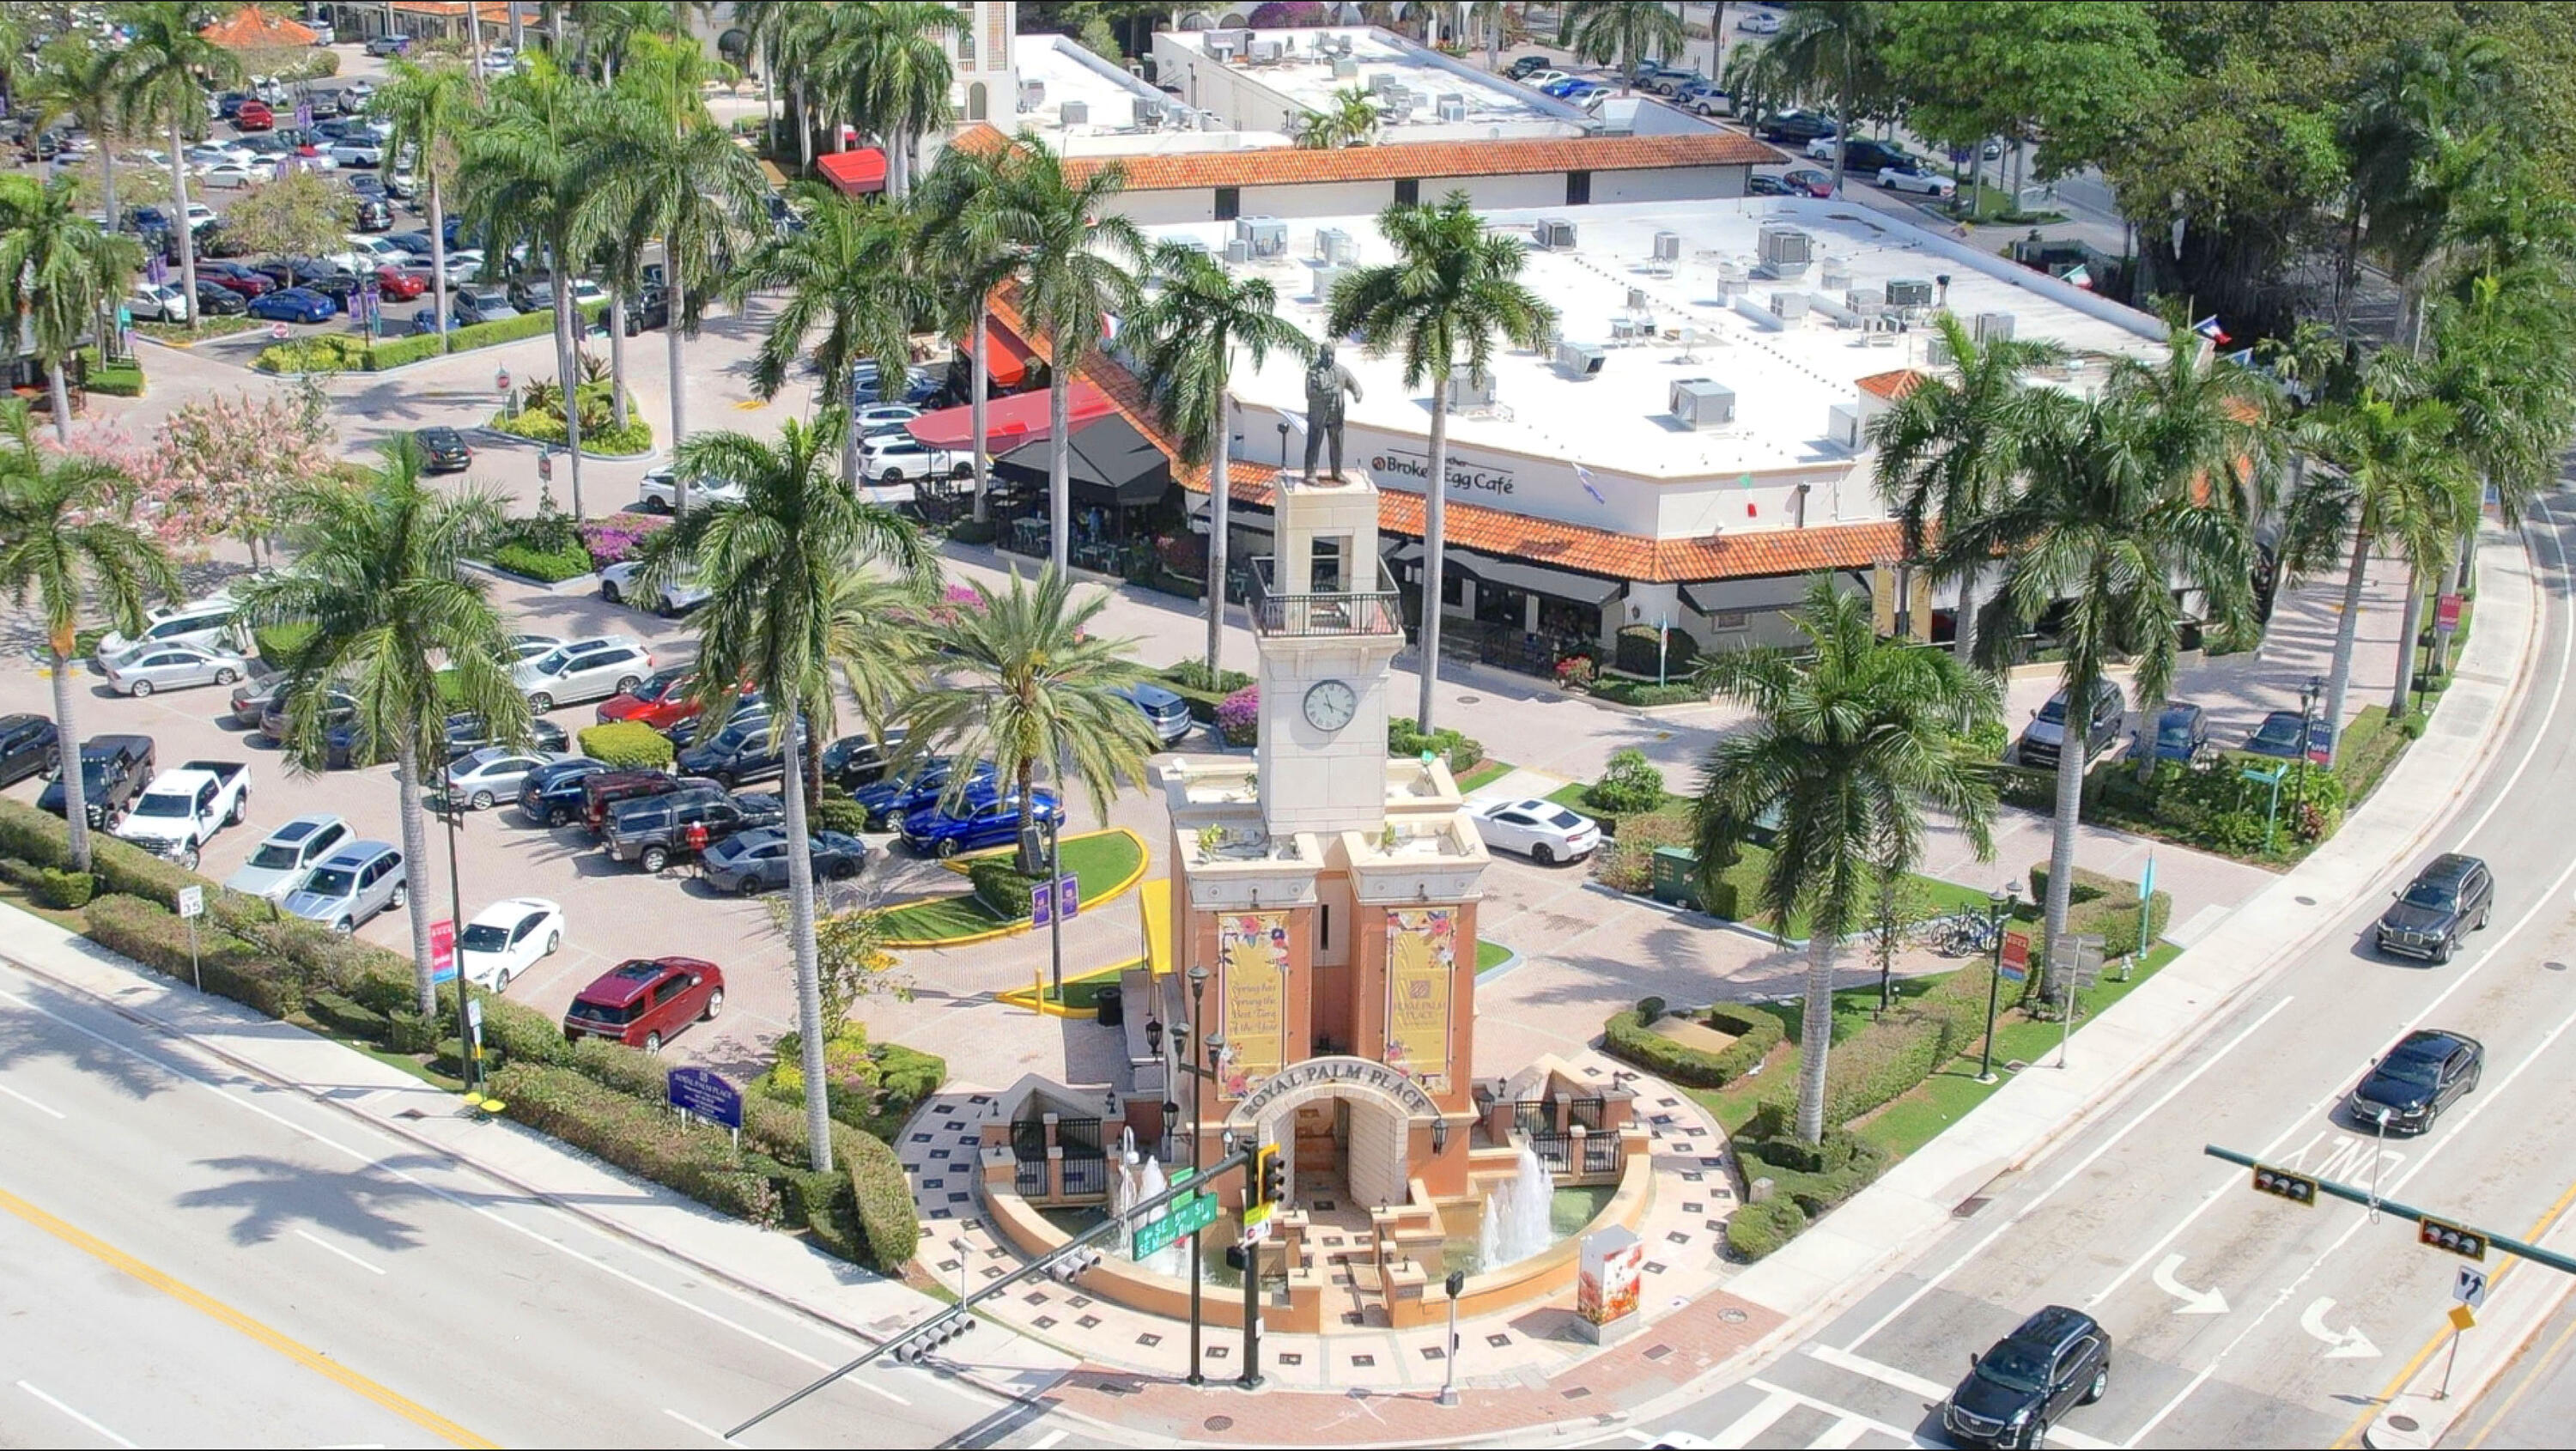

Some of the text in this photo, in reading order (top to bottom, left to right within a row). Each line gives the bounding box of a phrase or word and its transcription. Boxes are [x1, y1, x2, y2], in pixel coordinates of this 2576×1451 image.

[1387, 456, 1429, 479] Broke
[1474, 473, 1514, 495] Café
[183, 901, 201, 914] 35
[1394, 1001, 1446, 1011] ROYAL PALM
[1406, 1011, 1434, 1020] PLACE
[1242, 1064, 1426, 1119] ROYAL PALM PLACE
[2275, 1130, 2407, 1192] ONLY
[1155, 1222, 1168, 1236] SE
[1138, 1239, 1151, 1257] SE
